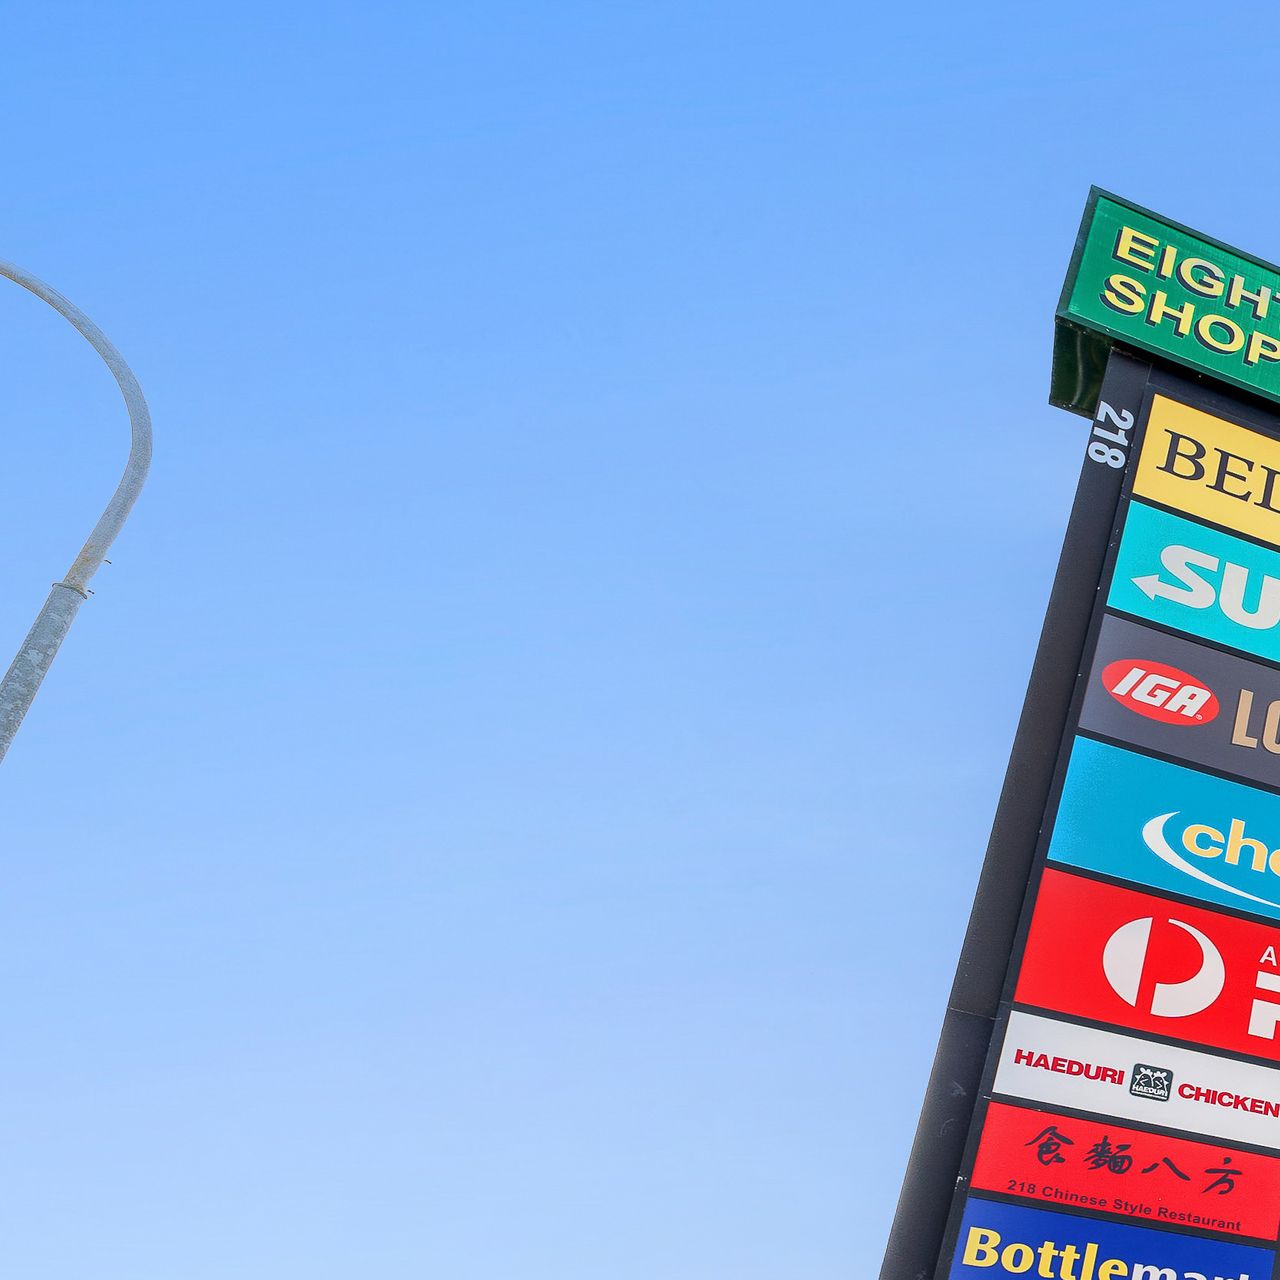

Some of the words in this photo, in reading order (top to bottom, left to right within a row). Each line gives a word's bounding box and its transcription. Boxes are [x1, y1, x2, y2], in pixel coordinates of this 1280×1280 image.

[1088, 401, 1134, 468] 218
[1110, 667, 1213, 720] IGA
[1014, 1047, 1125, 1086] HAEDURI
[1178, 1083, 1280, 1118] CHICKEN
[1132, 1084, 1168, 1097] HAEDURI
[1007, 1179, 1037, 1195] 218
[1041, 1185, 1107, 1208] Chinese
[1112, 1198, 1152, 1218] Style
[1157, 1205, 1242, 1232] Restaurant
